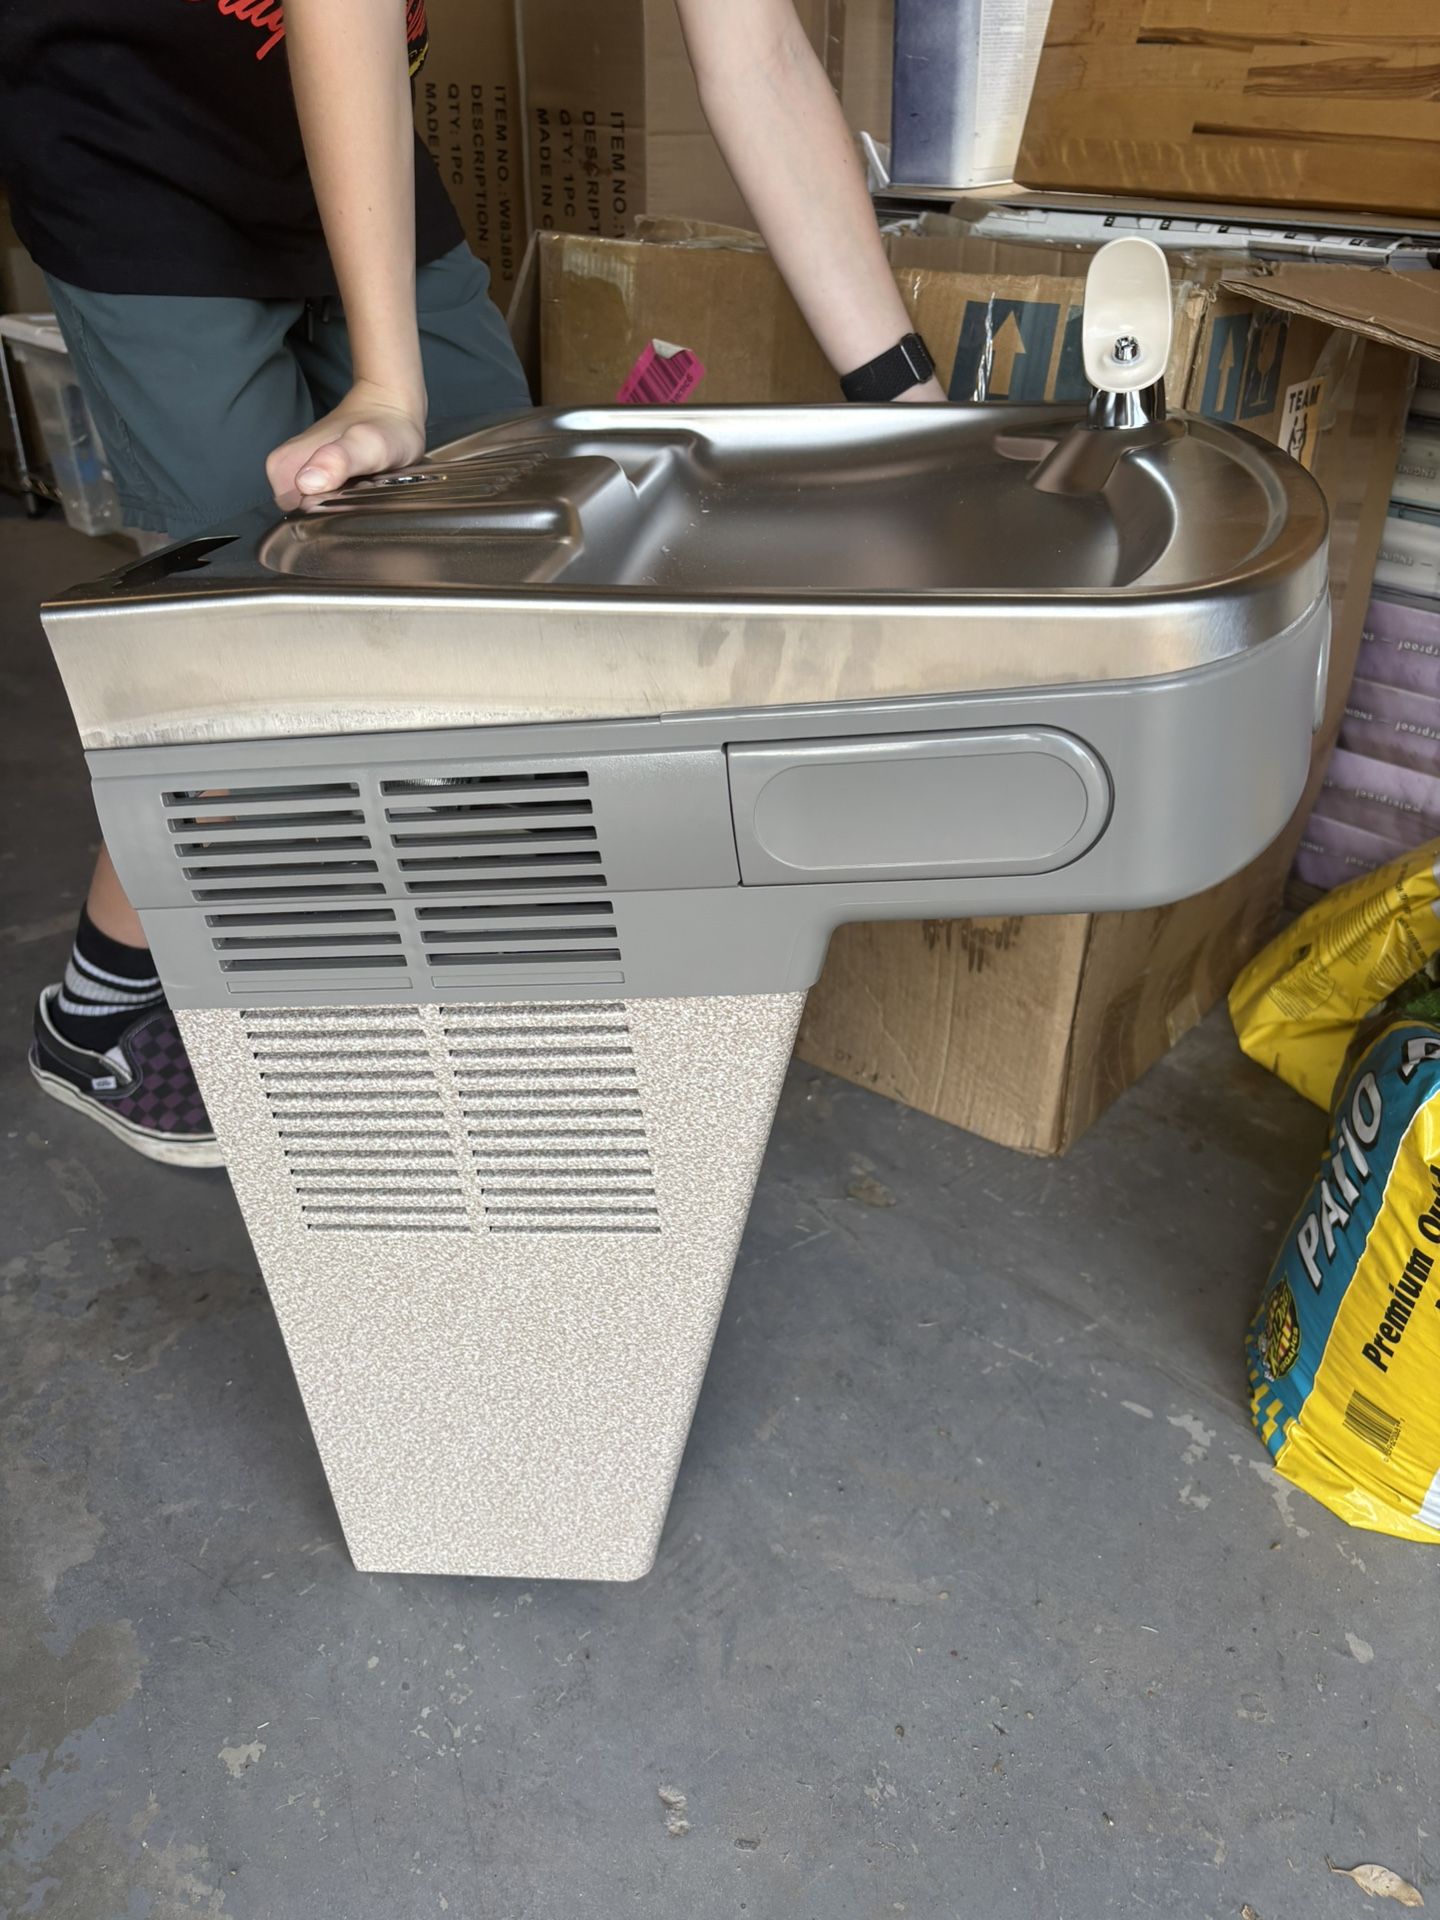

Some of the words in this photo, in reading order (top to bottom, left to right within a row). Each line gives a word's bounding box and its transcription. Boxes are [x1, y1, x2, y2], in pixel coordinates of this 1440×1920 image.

[425, 82, 441, 146] MADE
[447, 83, 462, 135] QTY:
[494, 85, 508, 141] ITEM
[559, 109, 574, 165] QTY:
[451, 145, 463, 186] 1PC
[536, 108, 553, 176] MADE
[611, 111, 625, 170] ITEM
[542, 184, 554, 207] IN
[563, 174, 576, 217] 1PC
[1289, 384, 1321, 414] TEAM
[1297, 1071, 1382, 1289] PATIO
[1362, 1247, 1434, 1373] Premium
